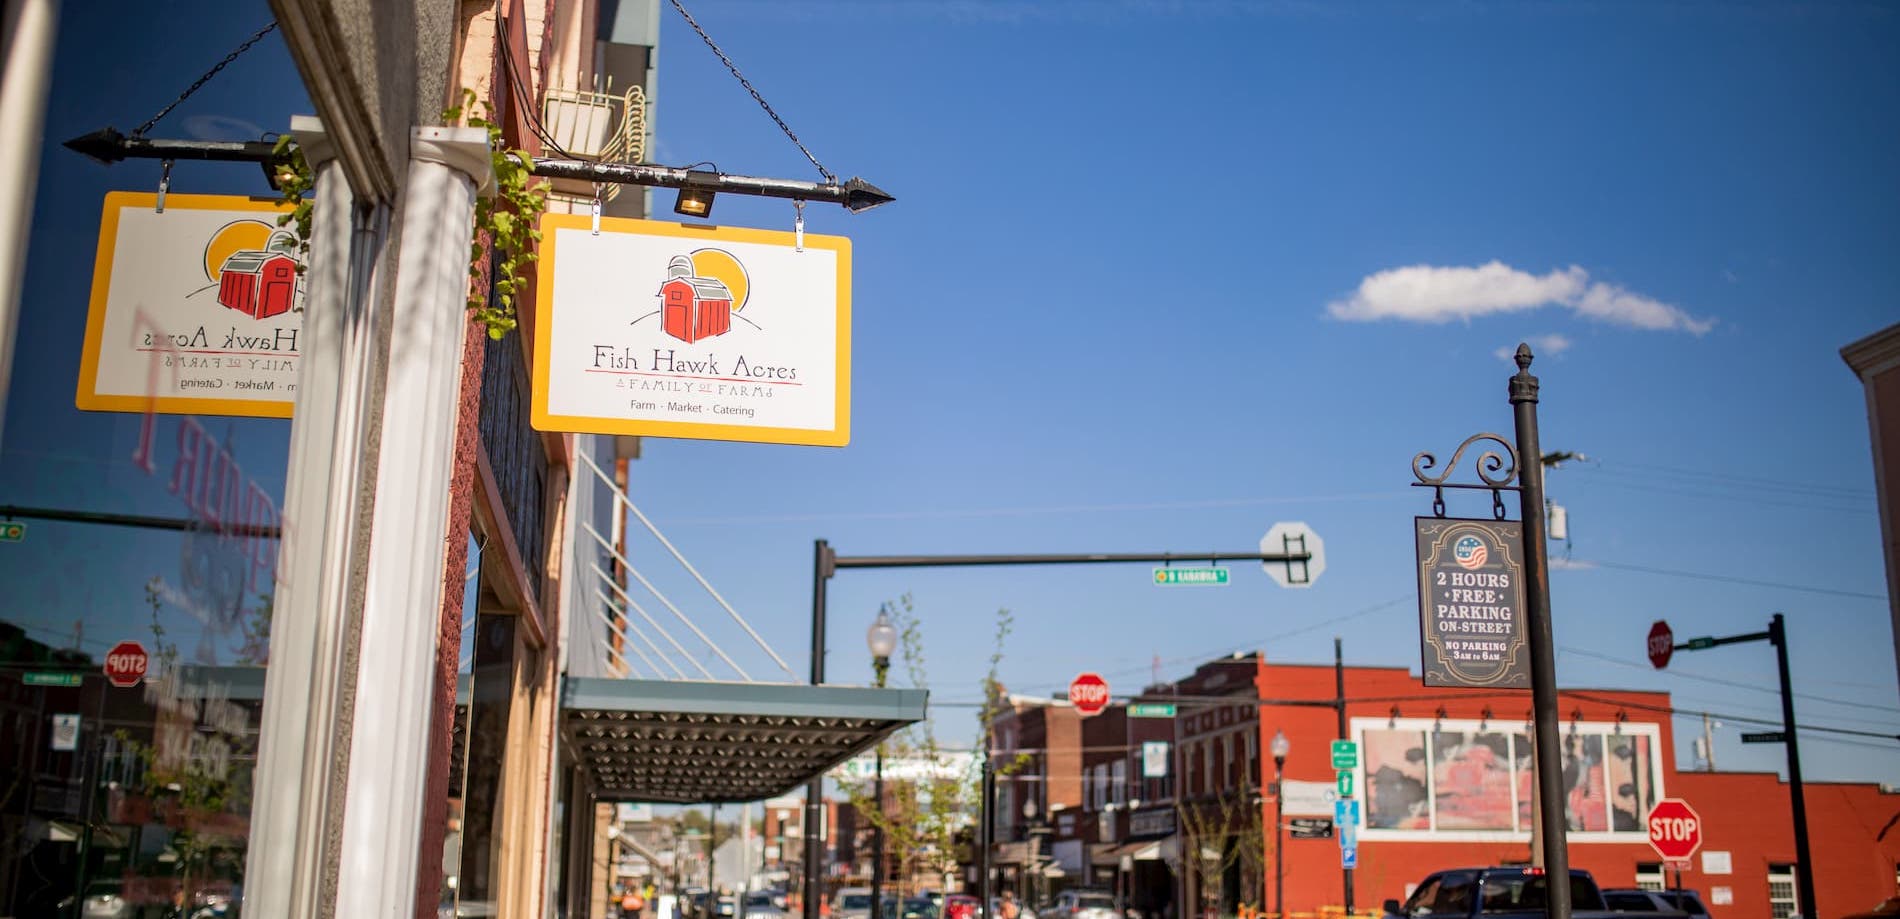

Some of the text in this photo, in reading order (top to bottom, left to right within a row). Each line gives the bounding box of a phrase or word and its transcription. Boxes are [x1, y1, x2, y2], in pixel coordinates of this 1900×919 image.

[593, 344, 797, 380] Fish Hawk Acres
[629, 378, 695, 393] FAMILY
[718, 384, 774, 398] FARMS
[630, 399, 755, 417] Farm Market Catering
[1437, 572, 1509, 588] 2 HOURS
[1451, 589, 1496, 604] FREE
[1437, 605, 1512, 621] PARKING
[1439, 621, 1512, 634] ON-STREET
[1445, 641, 1507, 651] NO PARKING
[1650, 634, 1671, 656] STOP
[1453, 651, 1472, 661] 3AM
[1071, 686, 1107, 702] STOP
[1650, 817, 1697, 841] STOP
